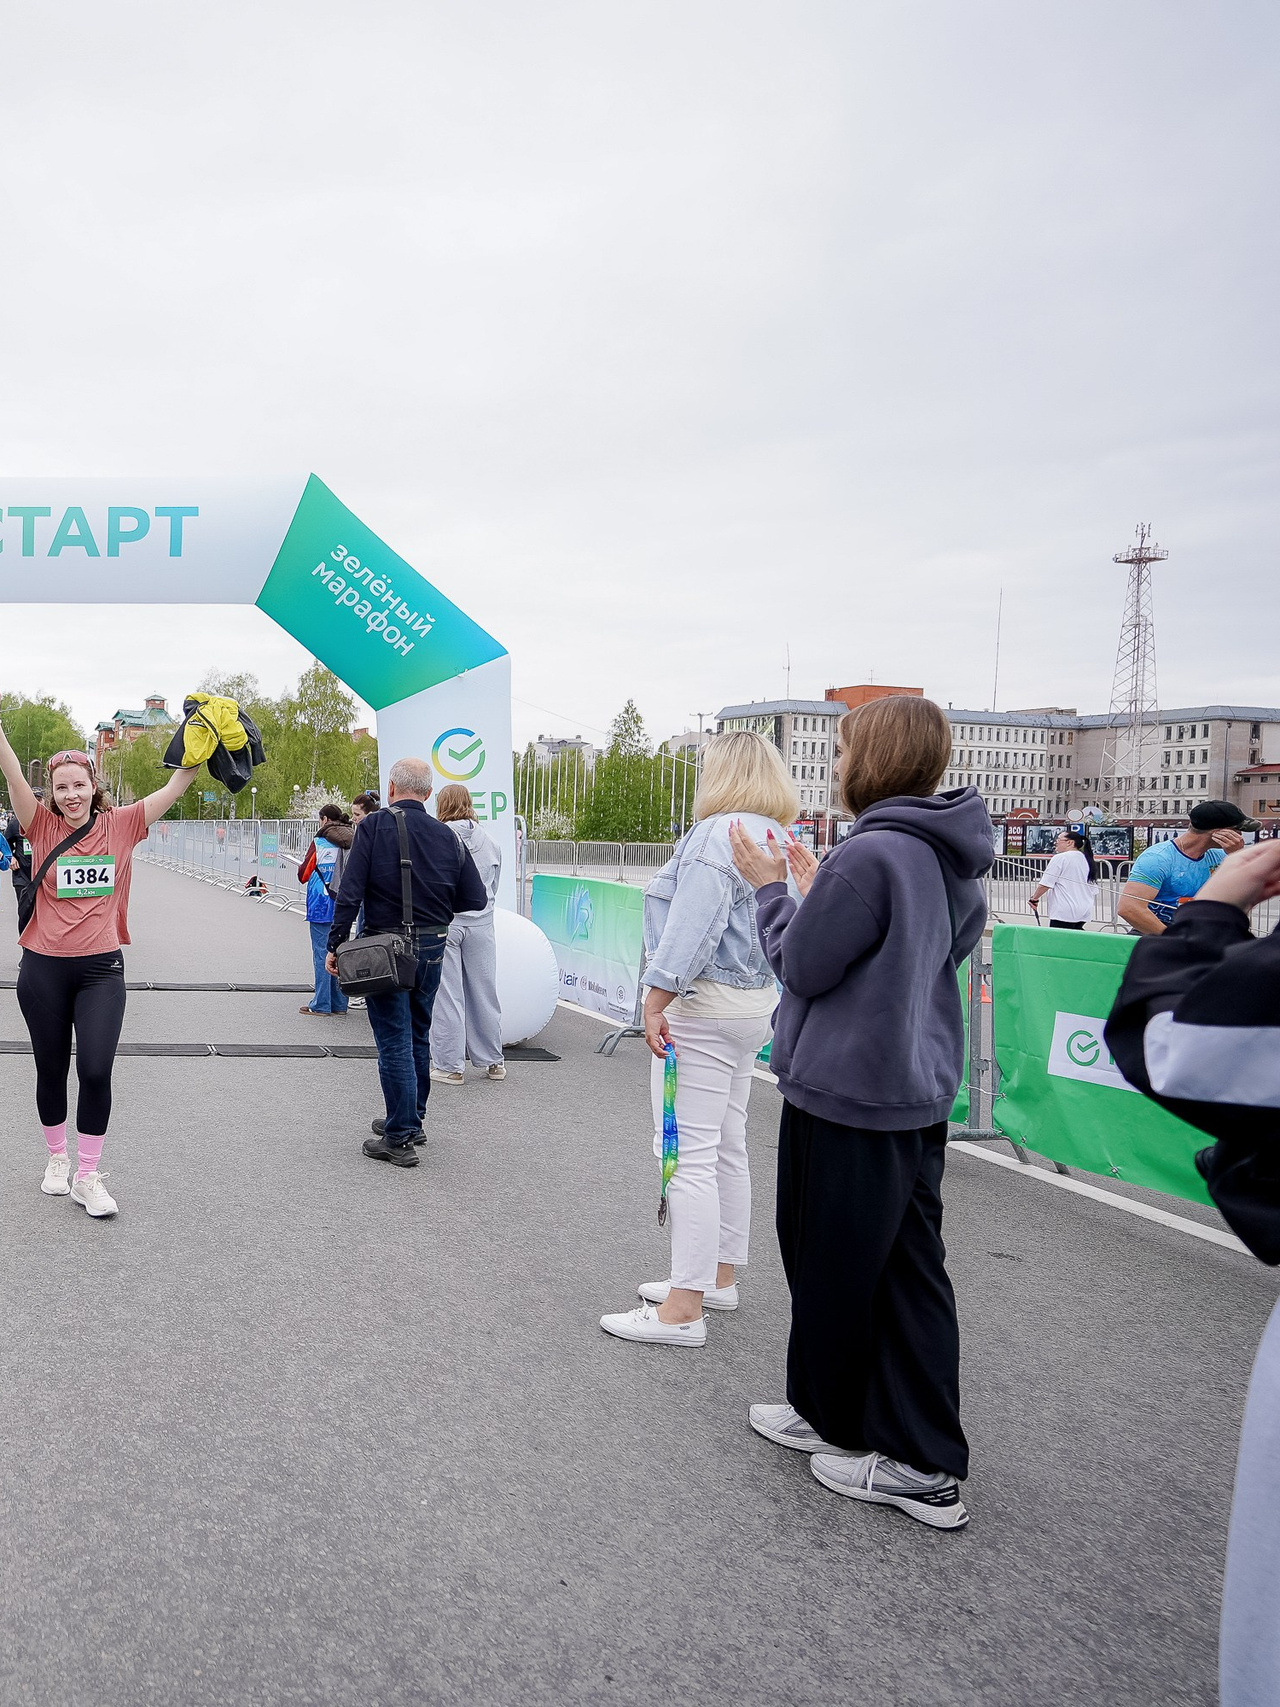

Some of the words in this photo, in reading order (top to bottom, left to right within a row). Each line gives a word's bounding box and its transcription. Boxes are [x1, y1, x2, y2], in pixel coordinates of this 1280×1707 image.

[311, 561, 415, 657] марафон
[330, 544, 436, 638] зелёный
[63, 867, 109, 885] 1384
